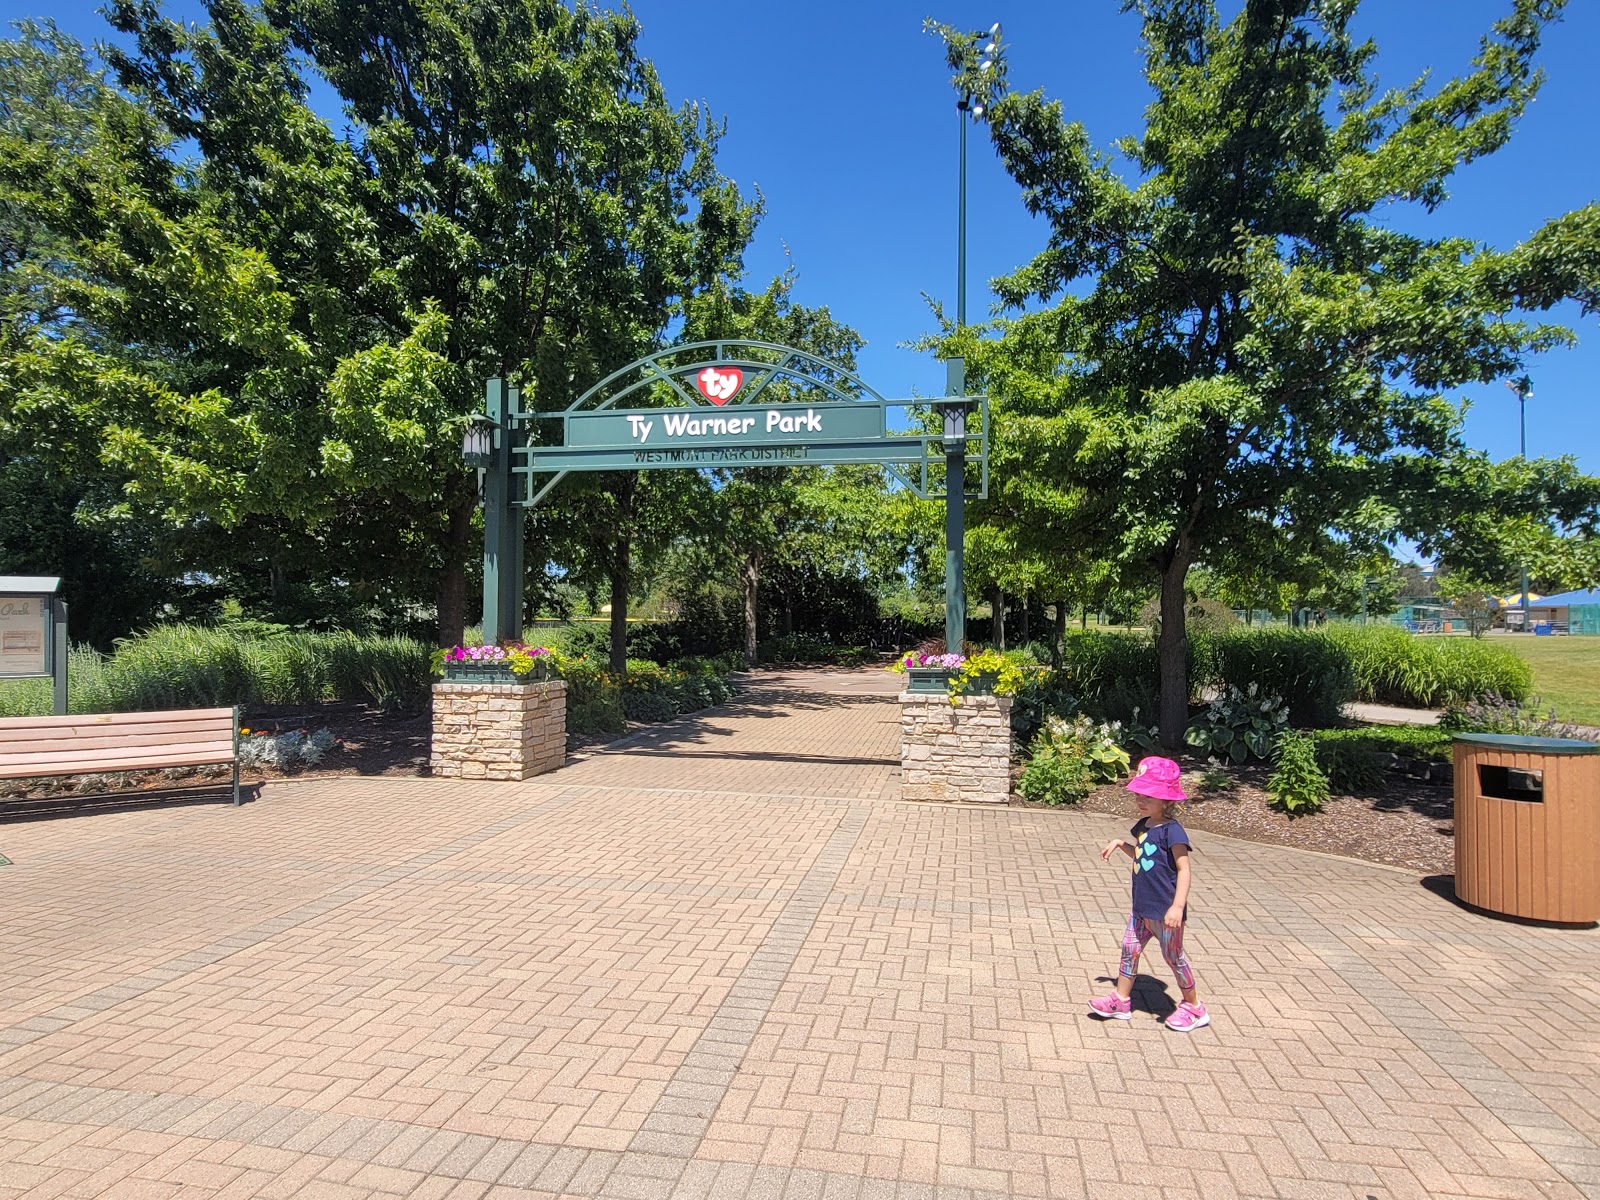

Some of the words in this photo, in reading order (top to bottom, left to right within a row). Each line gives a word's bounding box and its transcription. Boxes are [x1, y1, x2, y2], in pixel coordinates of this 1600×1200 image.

[700, 368, 738, 399] ty
[627, 415, 653, 443] Ty
[663, 413, 755, 437] Warner
[766, 408, 822, 433] Park
[633, 449, 705, 463] WESTMONT
[711, 447, 748, 461] PARK
[751, 446, 810, 460] DISTRICT
